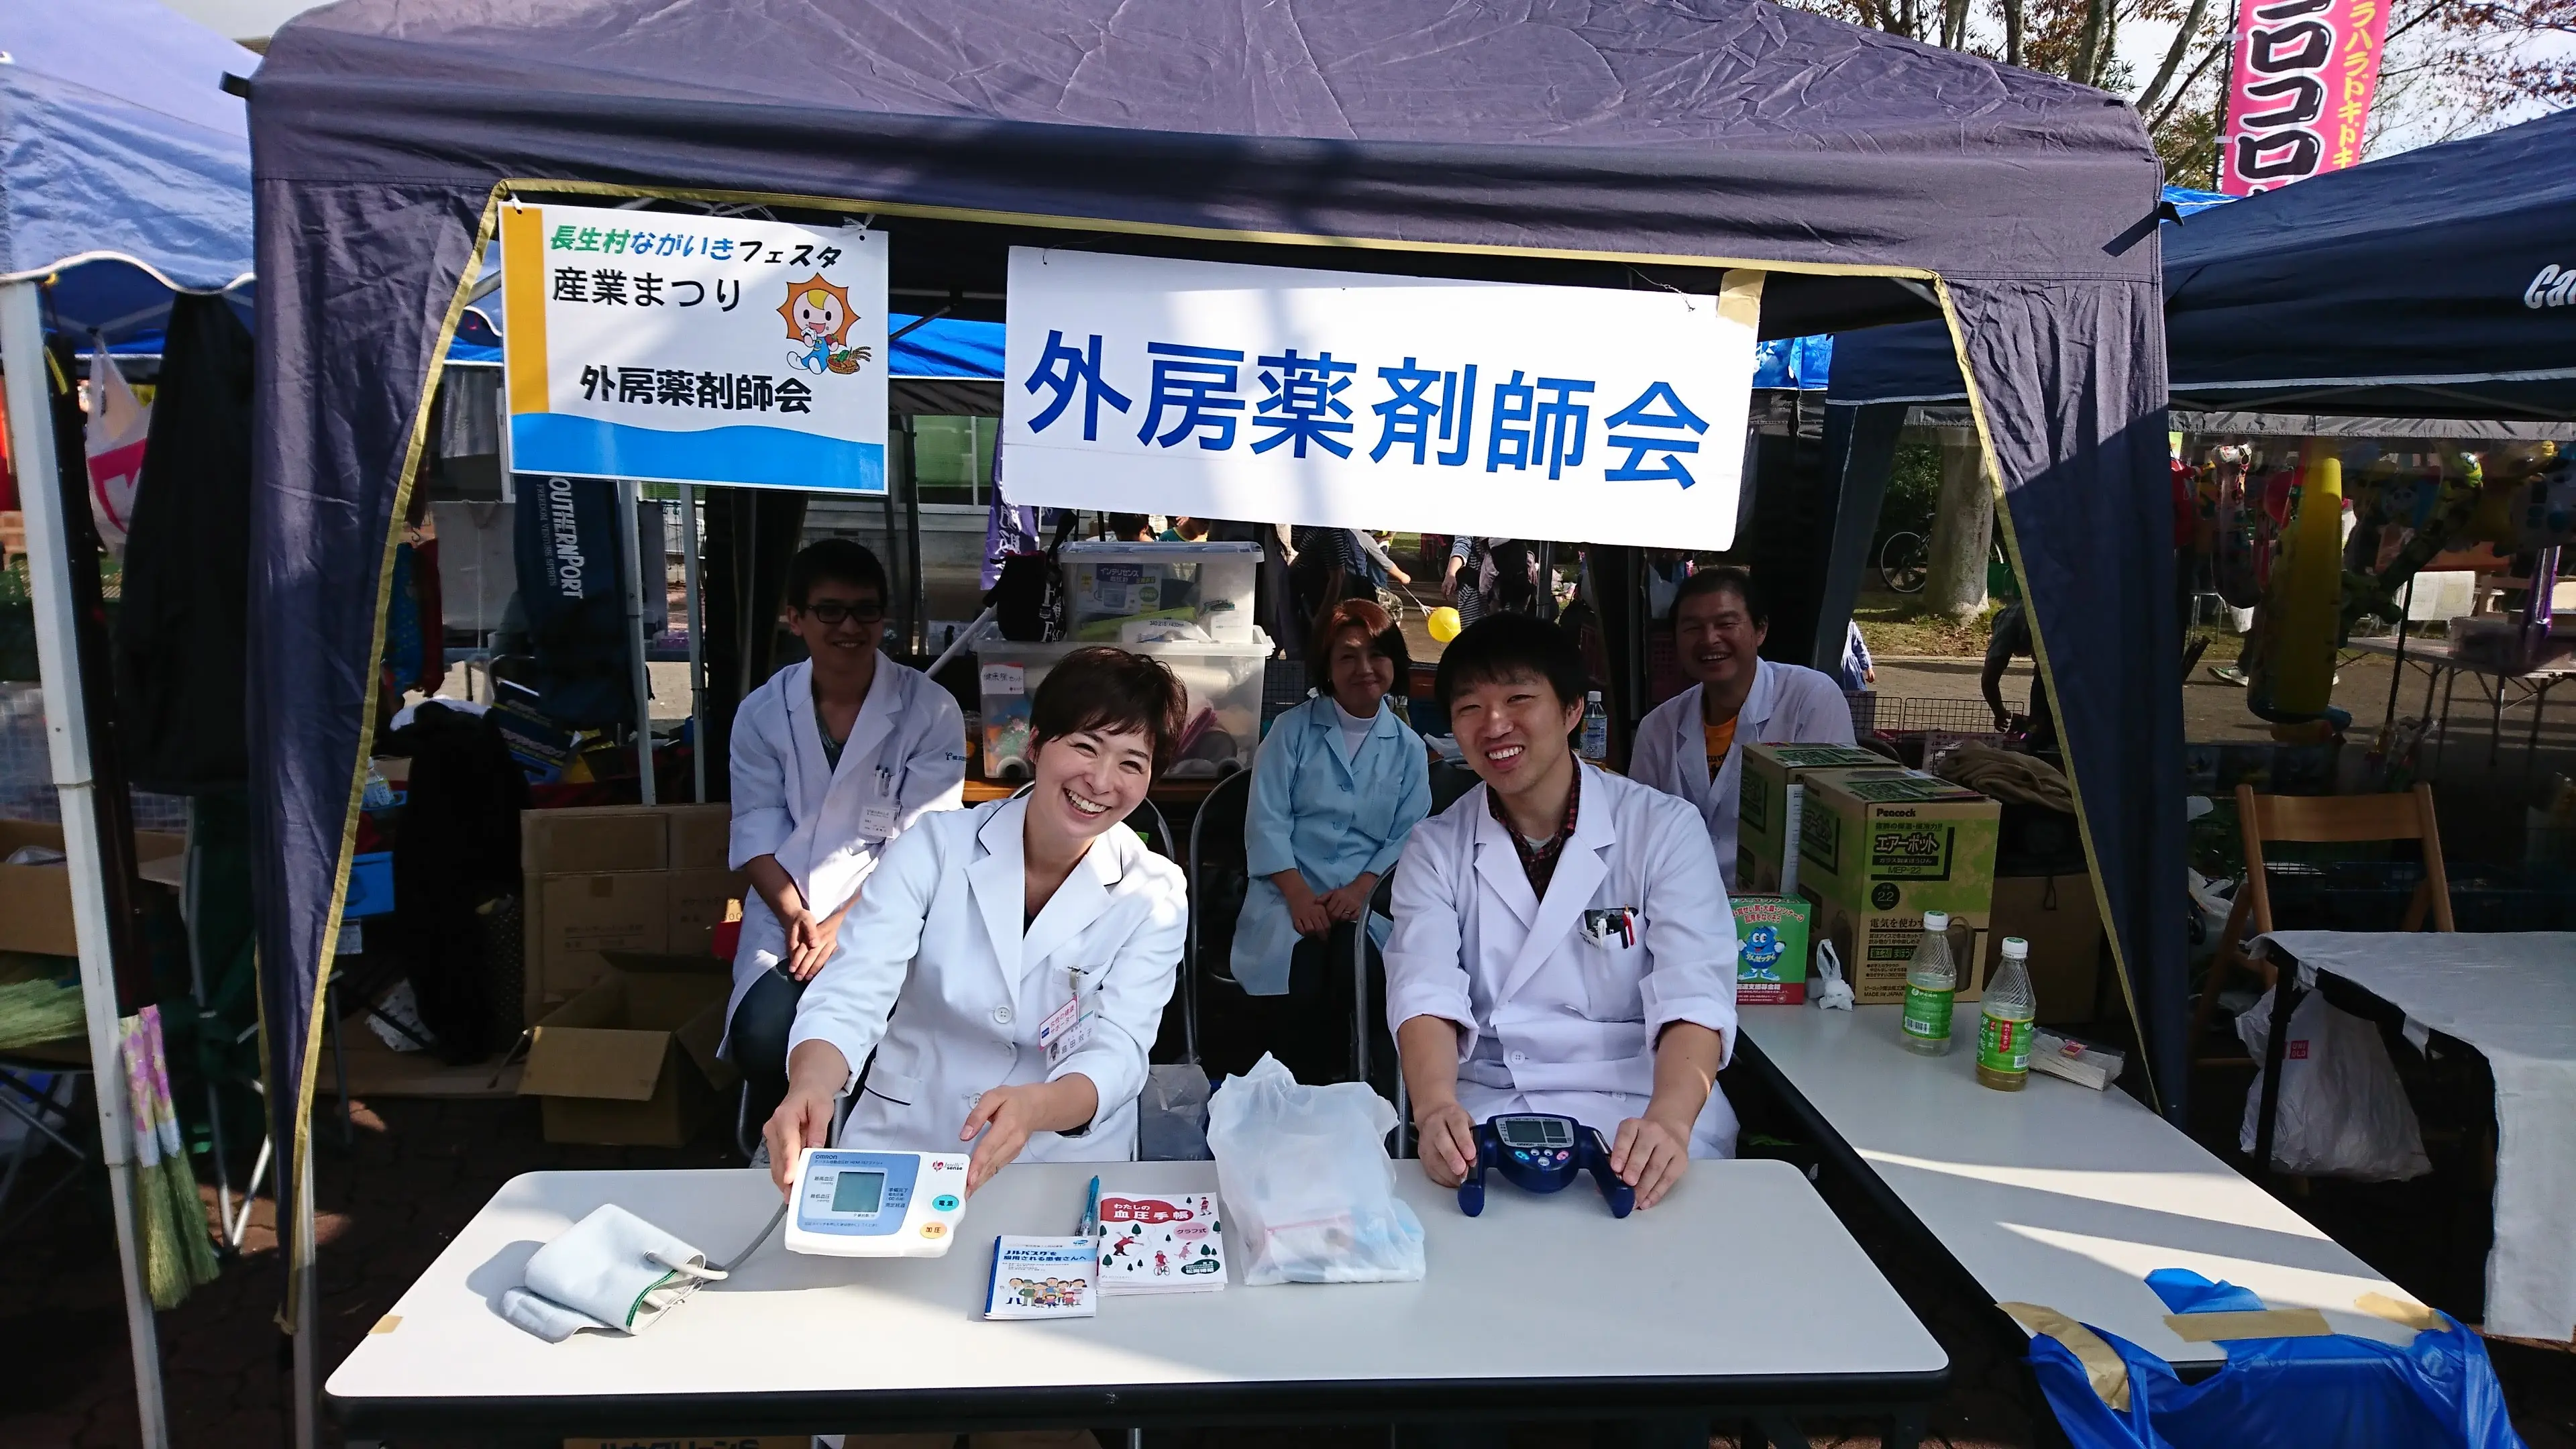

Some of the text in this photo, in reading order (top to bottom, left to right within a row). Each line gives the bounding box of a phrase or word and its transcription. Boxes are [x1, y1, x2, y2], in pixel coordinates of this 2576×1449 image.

[2237, 0, 2333, 195] ロコロ
[2332, 0, 2376, 168] ラハラドキドキ
[549, 225, 843, 270] 長生村ながいきフェスタ
[552, 266, 741, 313] 産業まつり
[2524, 264, 2576, 309] Ca
[580, 364, 814, 414] 外房薬剤師会
[1024, 329, 1710, 490] 外房薬剤師会
[549, 476, 586, 599] OUTHERNPORT
[1876, 808, 1916, 818] Peacock
[1875, 833, 1939, 854] エアーポット
[1888, 866, 1922, 874] MEP-22
[1114, 1210, 1190, 1220] 血圧手帳
